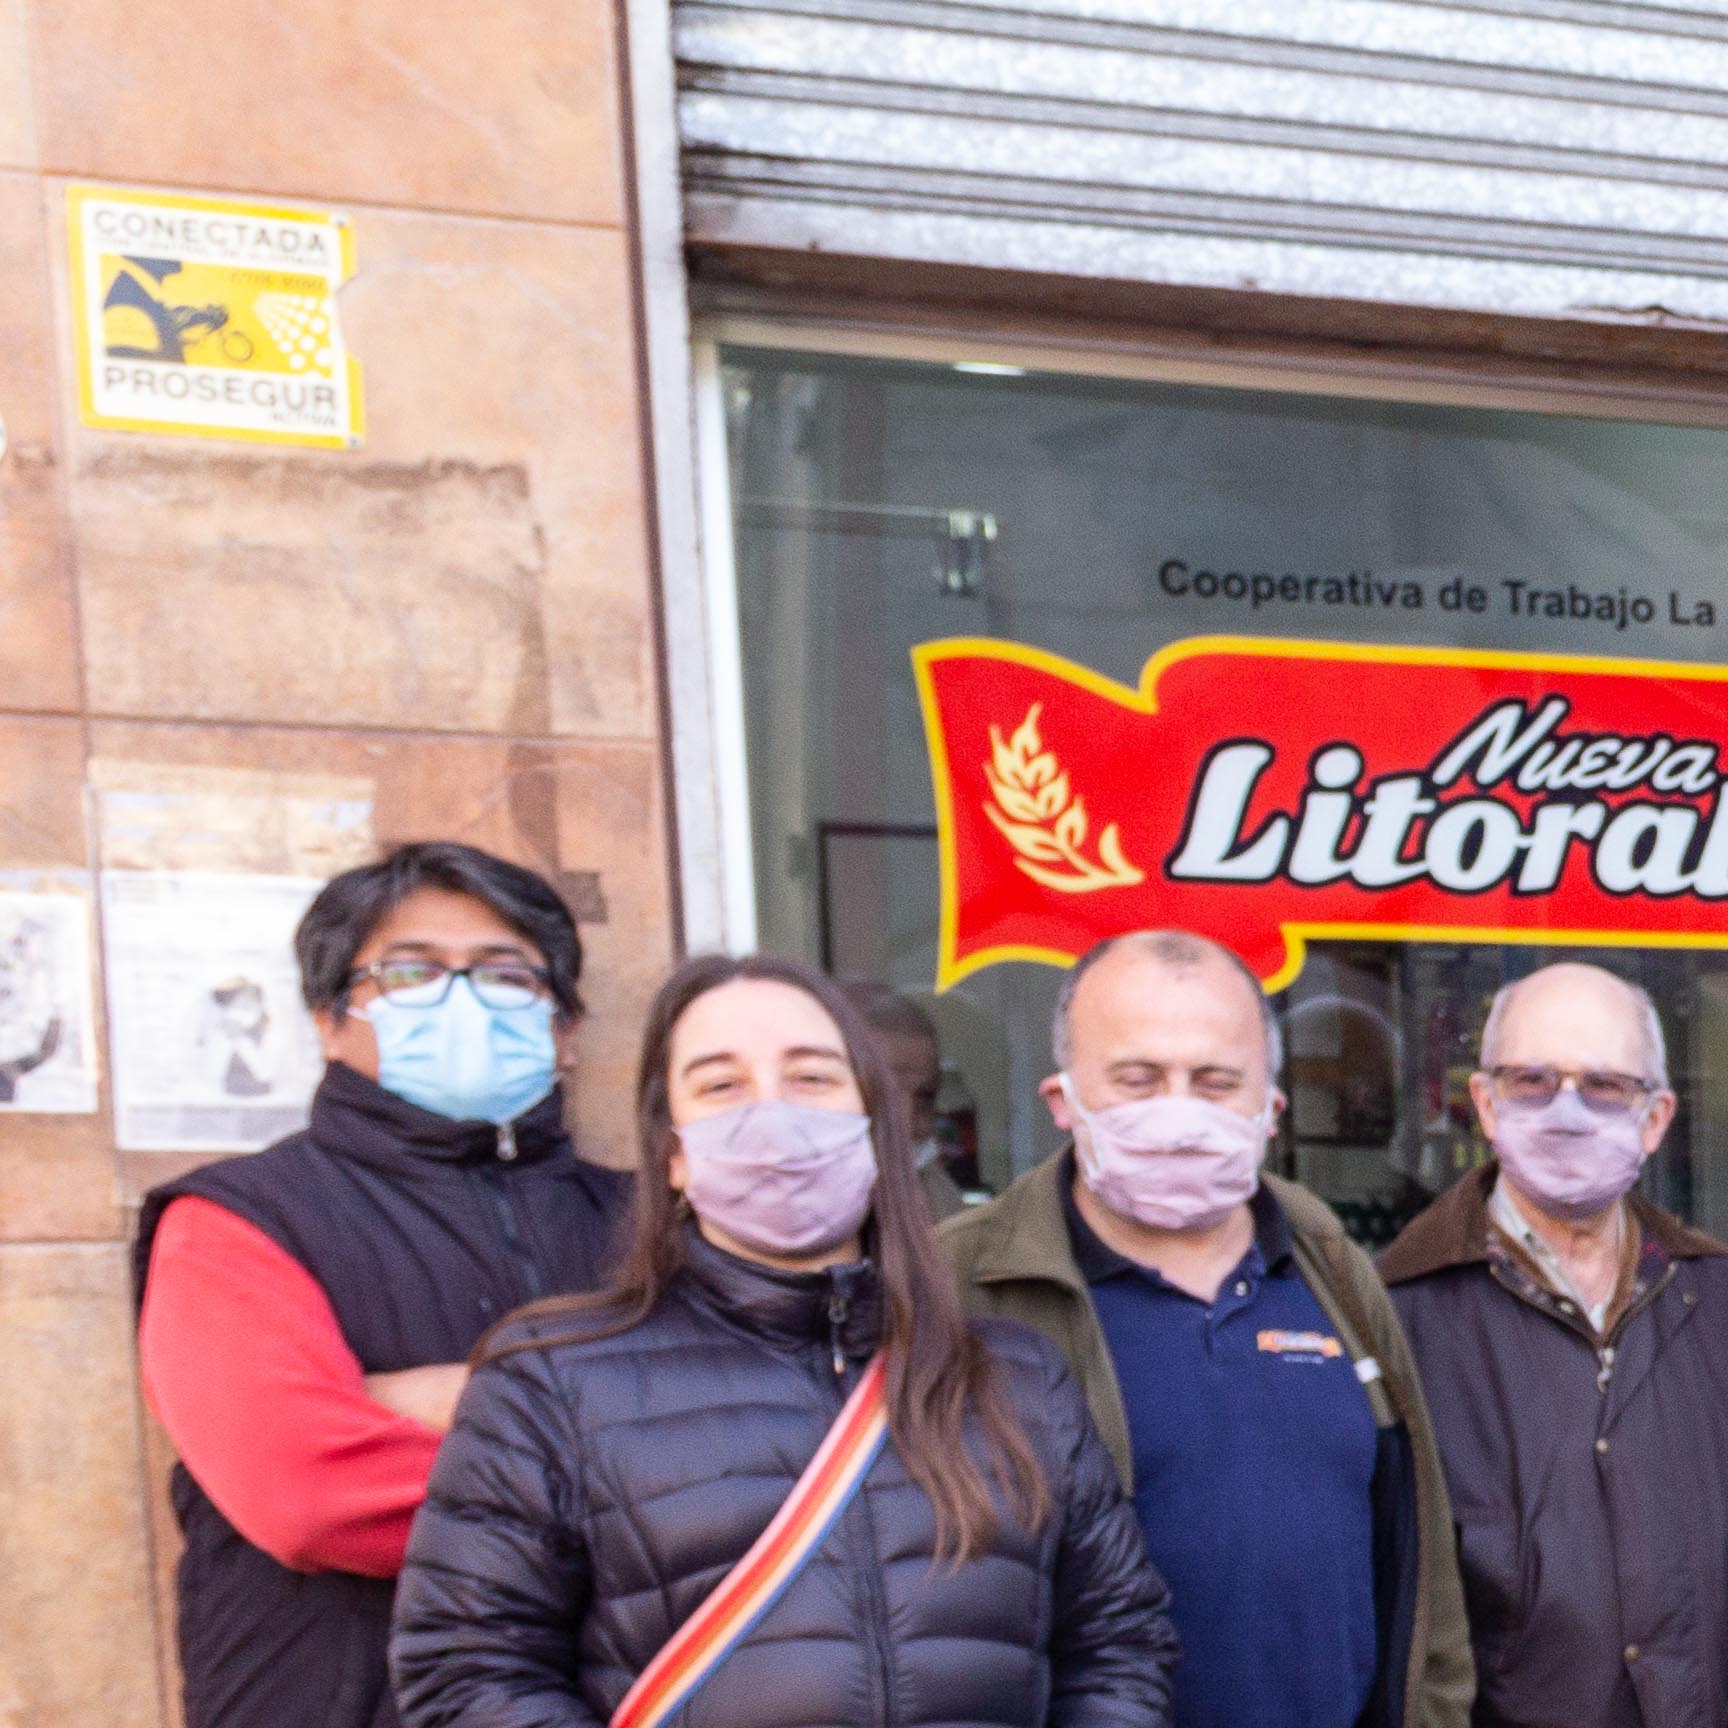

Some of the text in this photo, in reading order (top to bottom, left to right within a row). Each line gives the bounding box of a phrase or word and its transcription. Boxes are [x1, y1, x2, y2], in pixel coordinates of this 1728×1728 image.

[94, 209, 326, 254] CONECTADA
[104, 366, 337, 411] PROSEGUR
[1158, 558, 1424, 609] Cooperativa
[1437, 577, 1489, 613] de
[1502, 579, 1655, 630] Trabajo
[1669, 592, 1715, 626] La
[1429, 694, 1720, 798] Nueva
